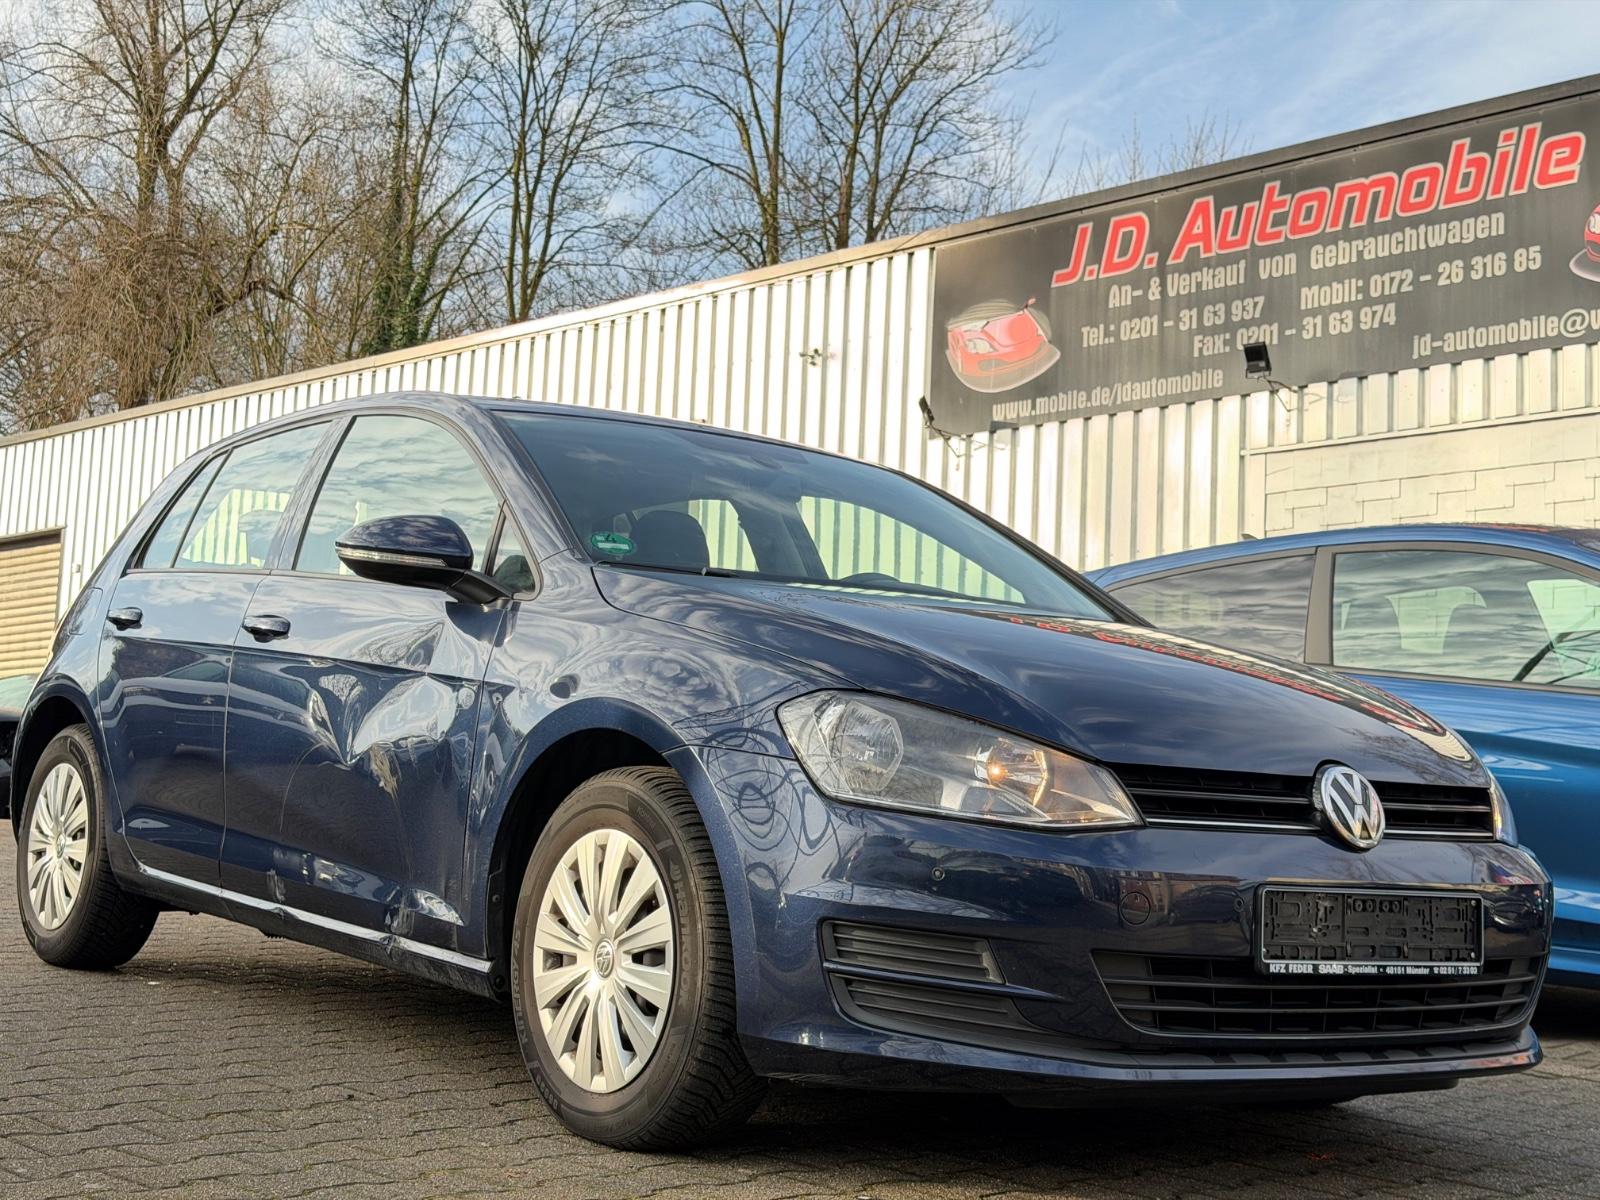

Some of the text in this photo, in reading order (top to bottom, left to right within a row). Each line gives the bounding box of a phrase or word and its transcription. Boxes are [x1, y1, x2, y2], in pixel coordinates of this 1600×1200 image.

[1050, 121, 1586, 288] J.D. Automobile
[1108, 211, 1506, 310] An- & Verkauf von Gebrauchtwagen
[1300, 278, 1364, 311] Mobil:
[1369, 269, 1413, 298] 0172
[1437, 259, 1465, 287] 26
[1470, 251, 1507, 280] 316
[1513, 246, 1542, 273] 85
[1081, 321, 1116, 350] Tel.:
[1119, 314, 1159, 342] 0201
[1179, 307, 1198, 332] 31
[1203, 302, 1226, 327] 63
[1231, 296, 1265, 323] 937
[1193, 332, 1231, 358] Fax:
[1236, 322, 1279, 350] 0201
[1302, 315, 1323, 340] 31
[1328, 310, 1354, 334] 63
[1359, 303, 1397, 329] 974
[1269, 963, 1286, 974] KFZ
[1288, 963, 1313, 974] FEDER
[1318, 963, 1344, 975] SAAB
